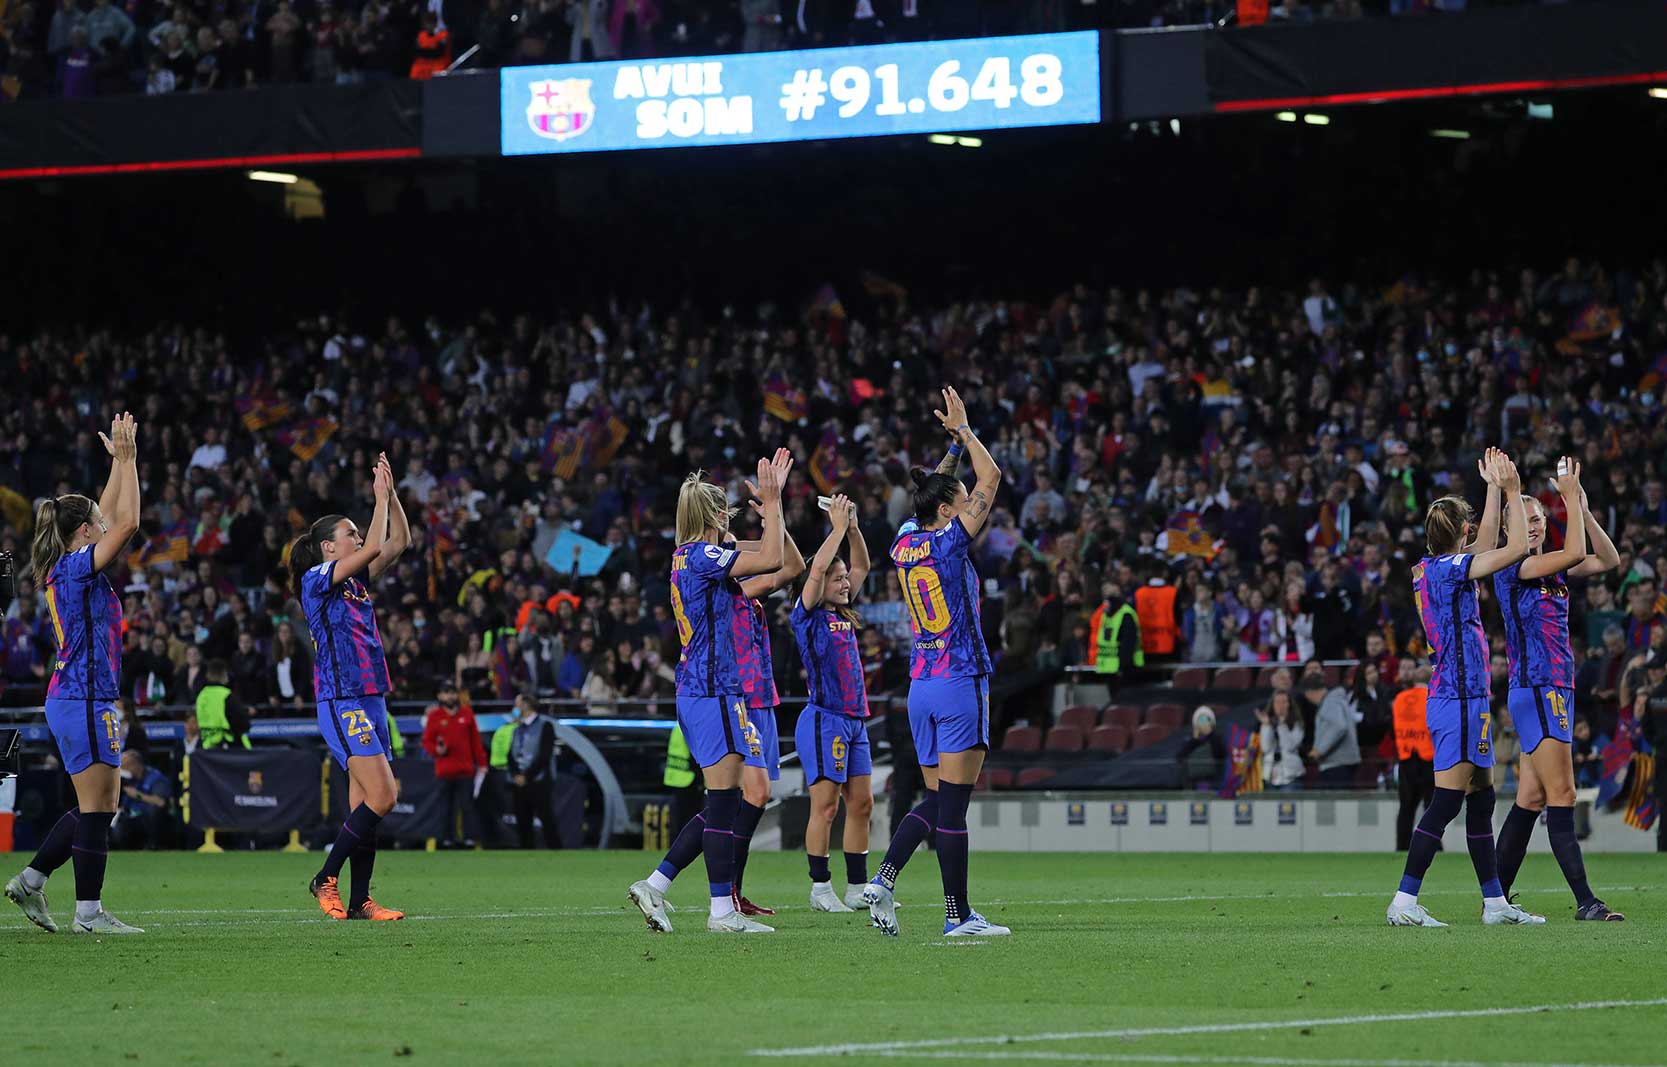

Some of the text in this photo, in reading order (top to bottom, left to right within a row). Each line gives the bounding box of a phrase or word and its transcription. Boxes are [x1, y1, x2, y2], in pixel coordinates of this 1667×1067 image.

[613, 62, 723, 99] AVUI
[779, 54, 1065, 121] #91.648
[636, 95, 753, 139] SOM
[897, 565, 952, 634] 10
[341, 710, 374, 737] 23
[1480, 713, 1491, 740] 7
[831, 736, 847, 760] 6
